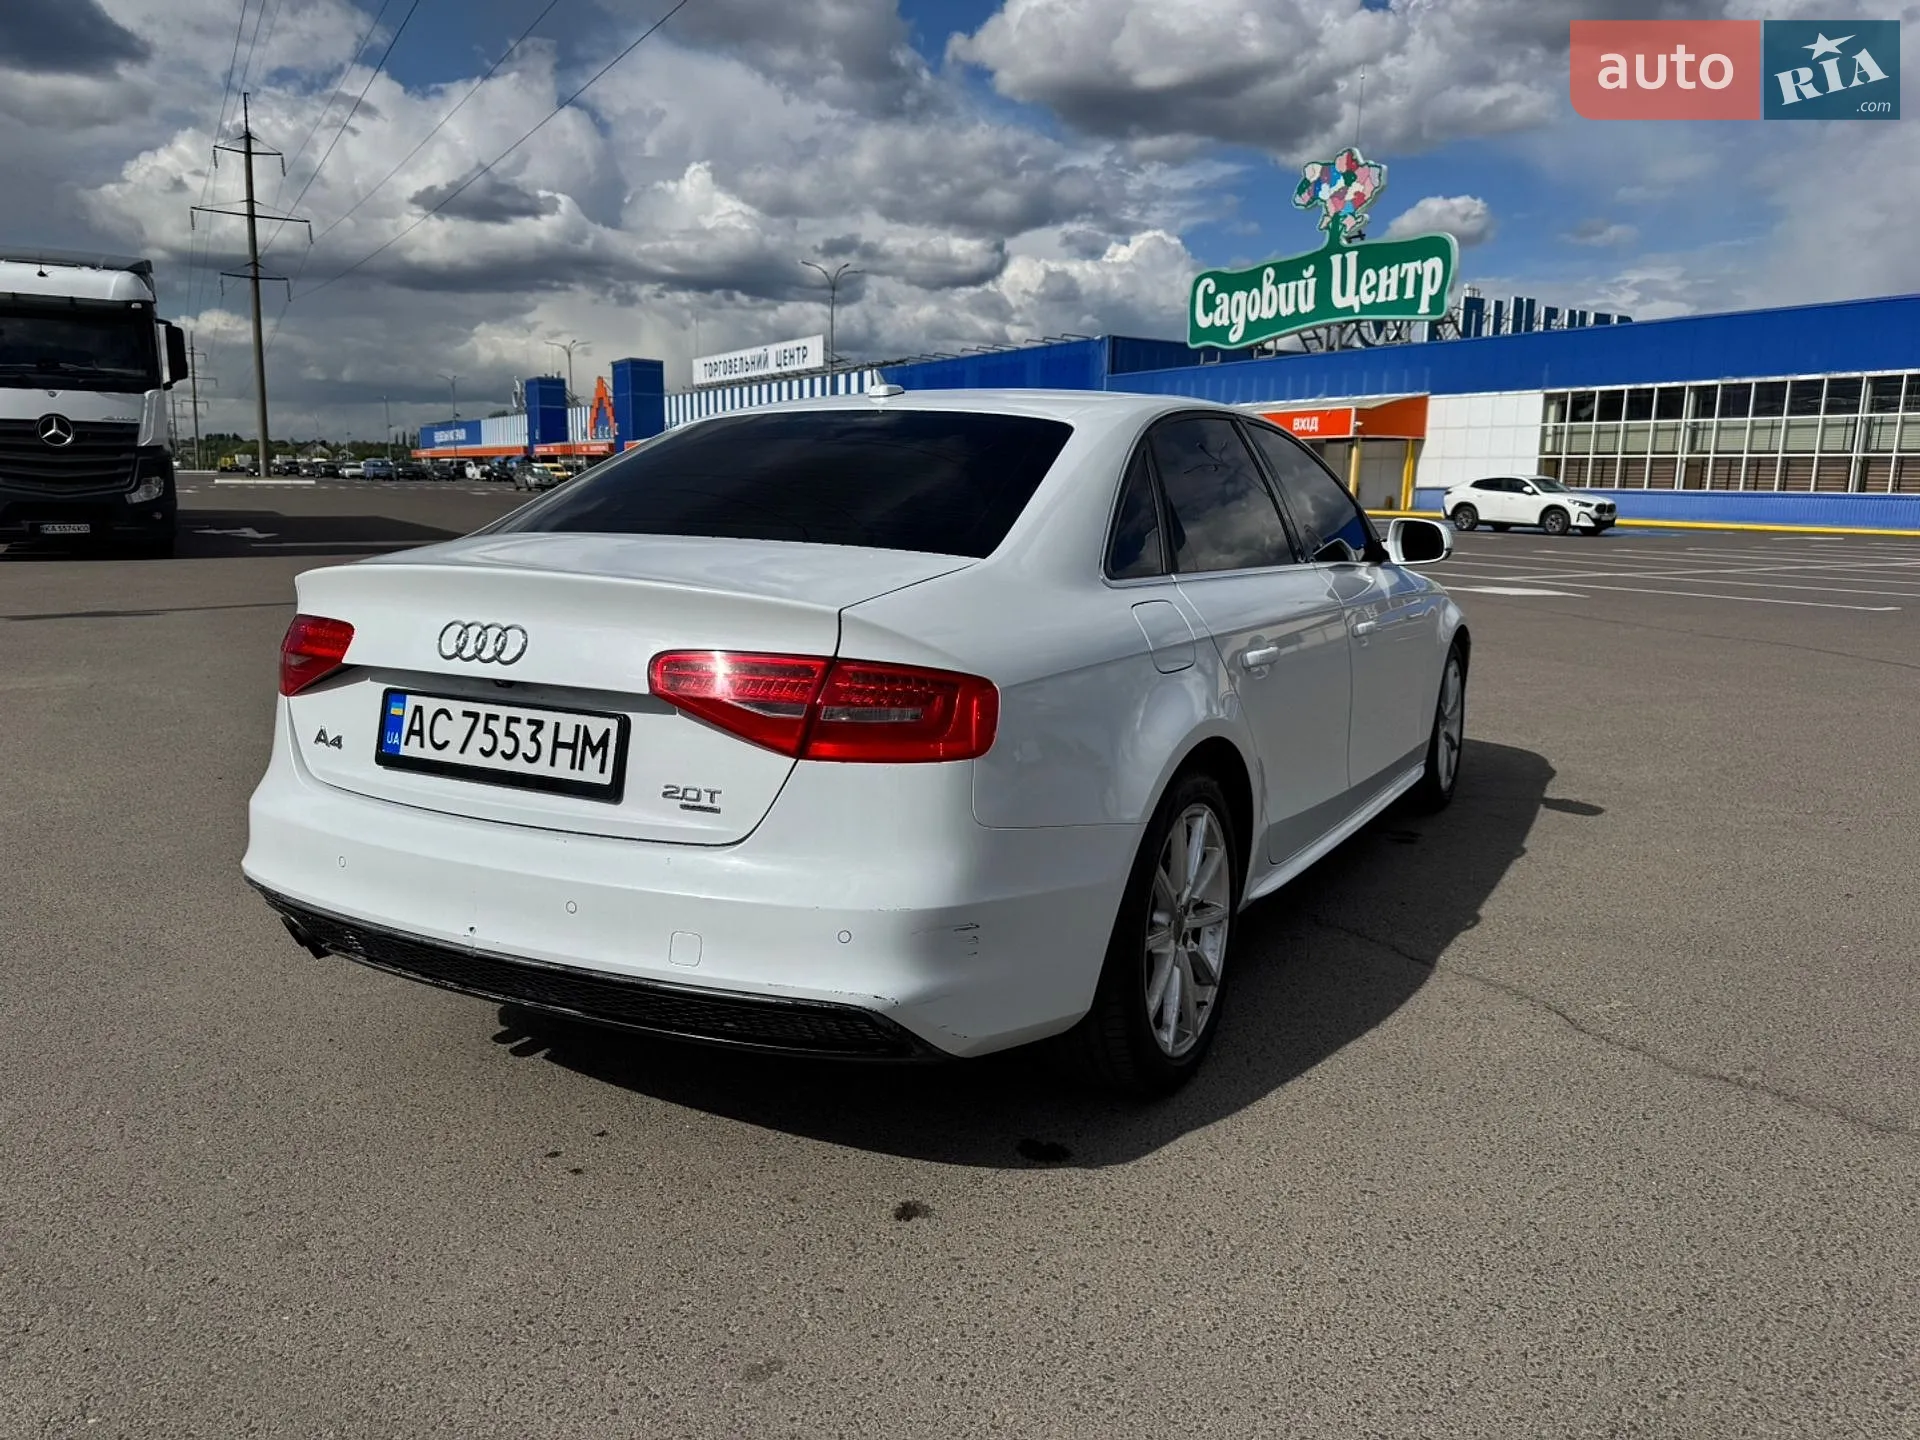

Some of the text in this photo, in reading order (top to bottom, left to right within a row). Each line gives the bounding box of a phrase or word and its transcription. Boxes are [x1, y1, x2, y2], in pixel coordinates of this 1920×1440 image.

[1195, 250, 1444, 343] Садовий Центр
[703, 345, 808, 379] ТОРГОВЕЛЬНИЙ ЦЕНТР
[1292, 416, 1319, 432] ВХІД
[313, 725, 343, 750] A4
[386, 731, 400, 745] UA
